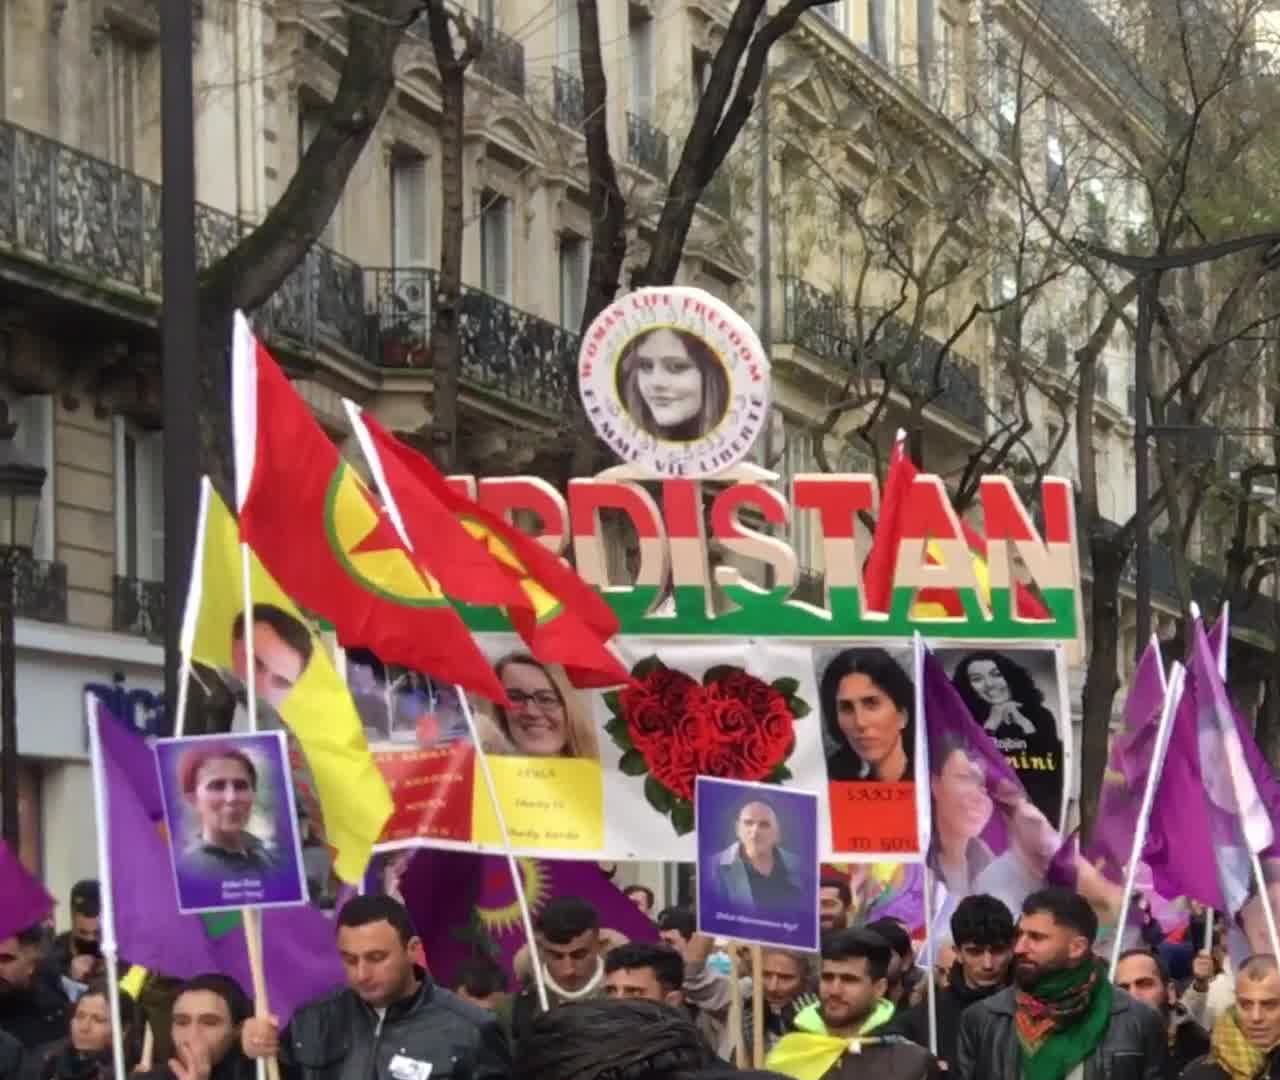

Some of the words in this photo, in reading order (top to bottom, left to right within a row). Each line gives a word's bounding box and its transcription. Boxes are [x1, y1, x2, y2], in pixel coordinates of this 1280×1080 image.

[582, 307, 625, 378] WOMAN
[631, 293, 673, 309] LIFE
[683, 296, 762, 383] FREEDOM
[583, 388, 639, 461] FEMME
[654, 459, 685, 476] VIE
[457, 473, 1077, 624] RDISTAN
